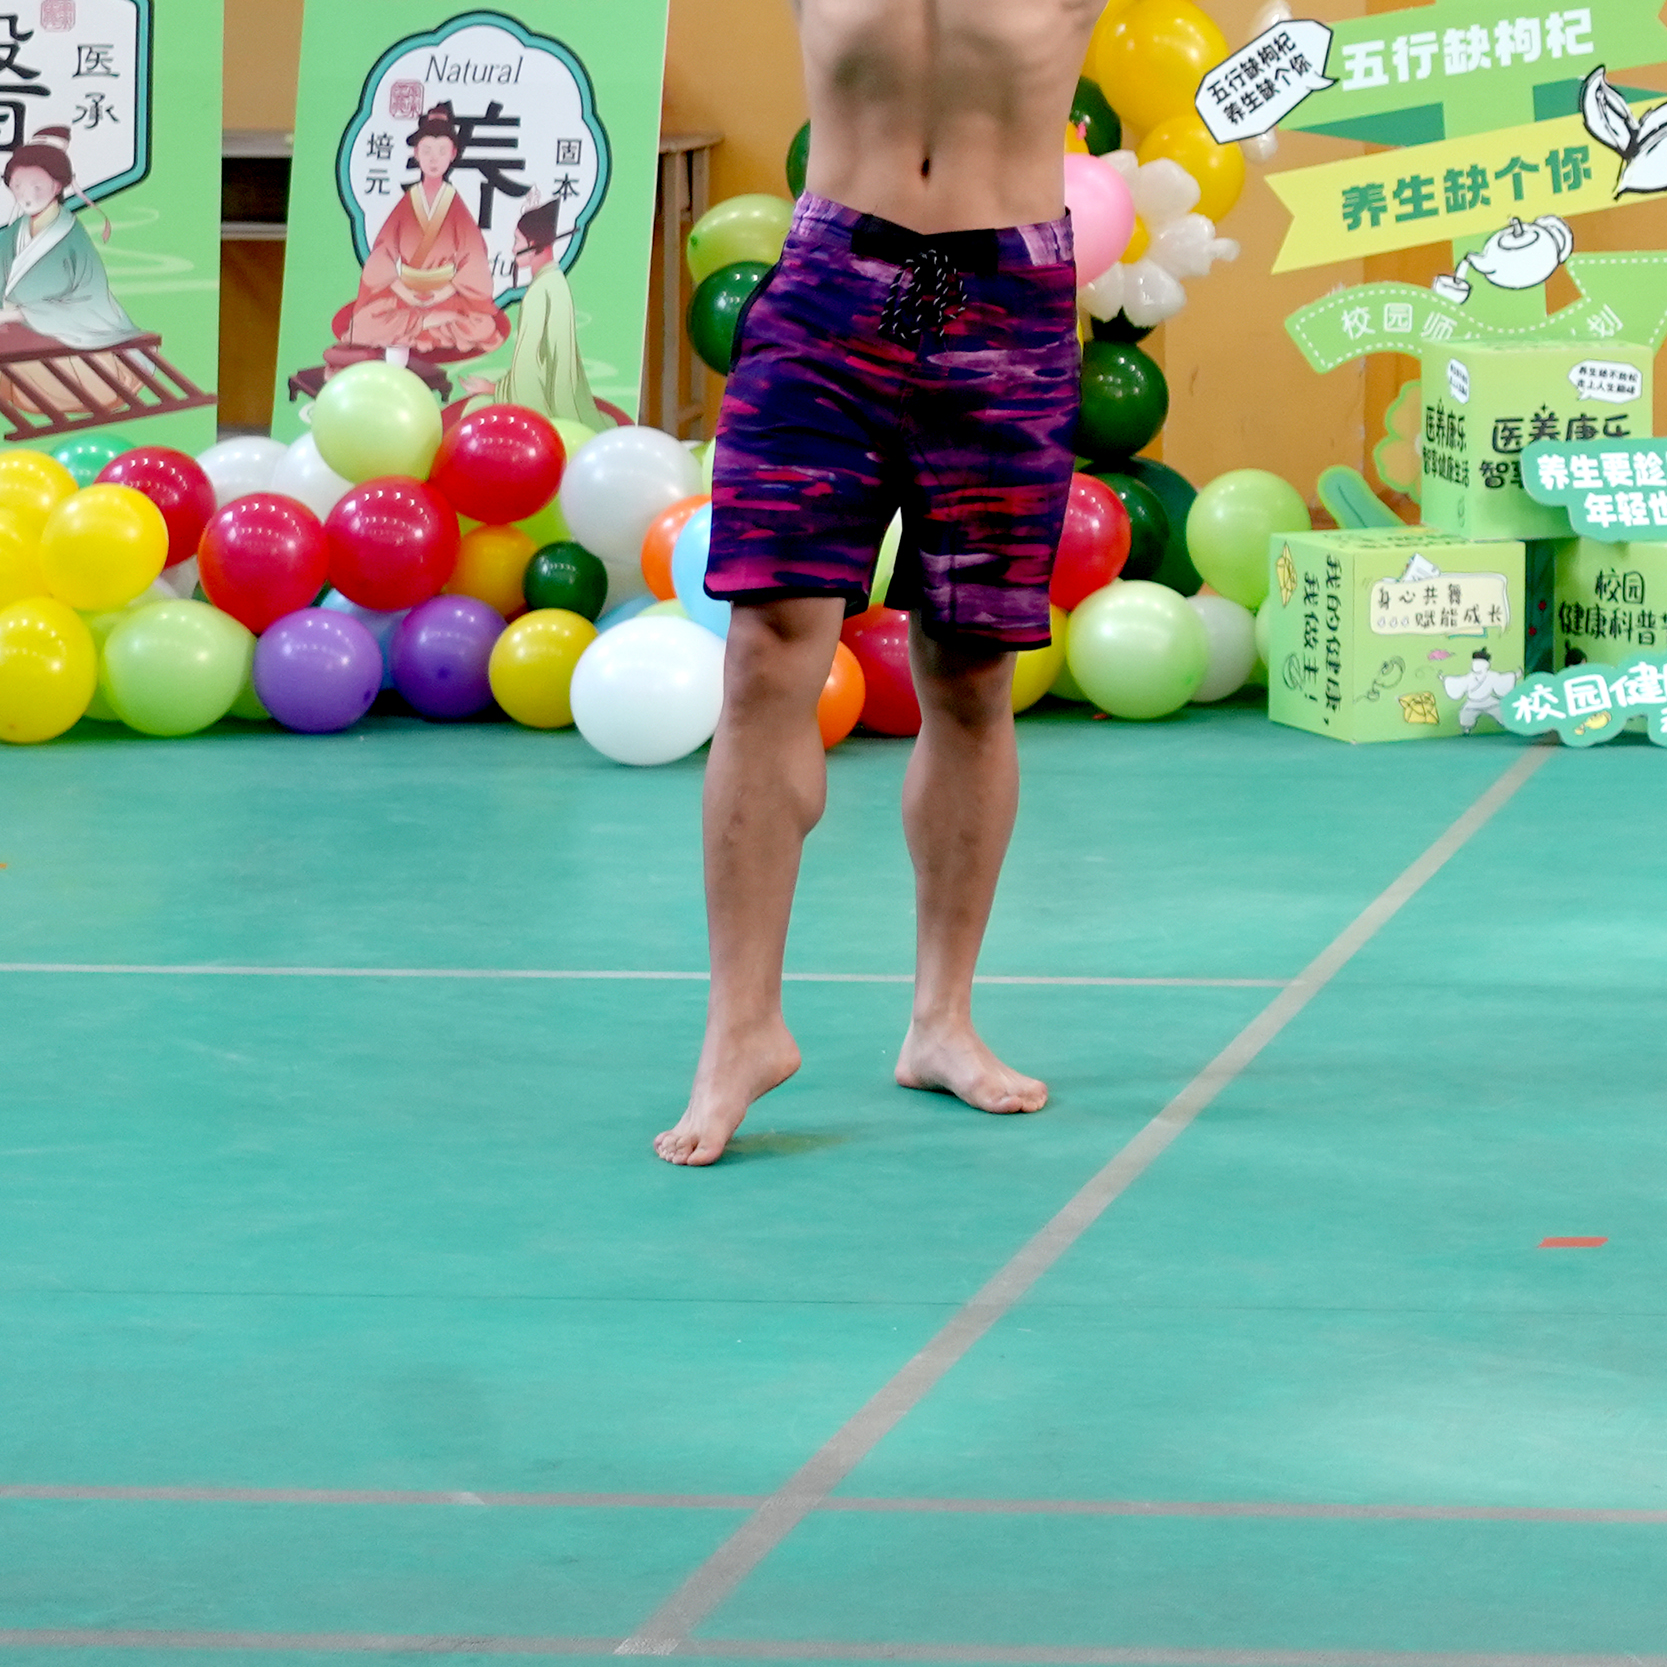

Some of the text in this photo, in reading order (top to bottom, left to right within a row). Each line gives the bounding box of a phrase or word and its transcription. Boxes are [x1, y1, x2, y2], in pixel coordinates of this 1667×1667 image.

[424, 54, 523, 86] Natural
[1206, 30, 1297, 105] 五行缺枸杞
[1340, 7, 1594, 92] 五行缺枸杞
[1222, 52, 1313, 126] 养生缺个你
[1341, 144, 1593, 232] 养生缺个你
[1595, 567, 1646, 605] 校园
